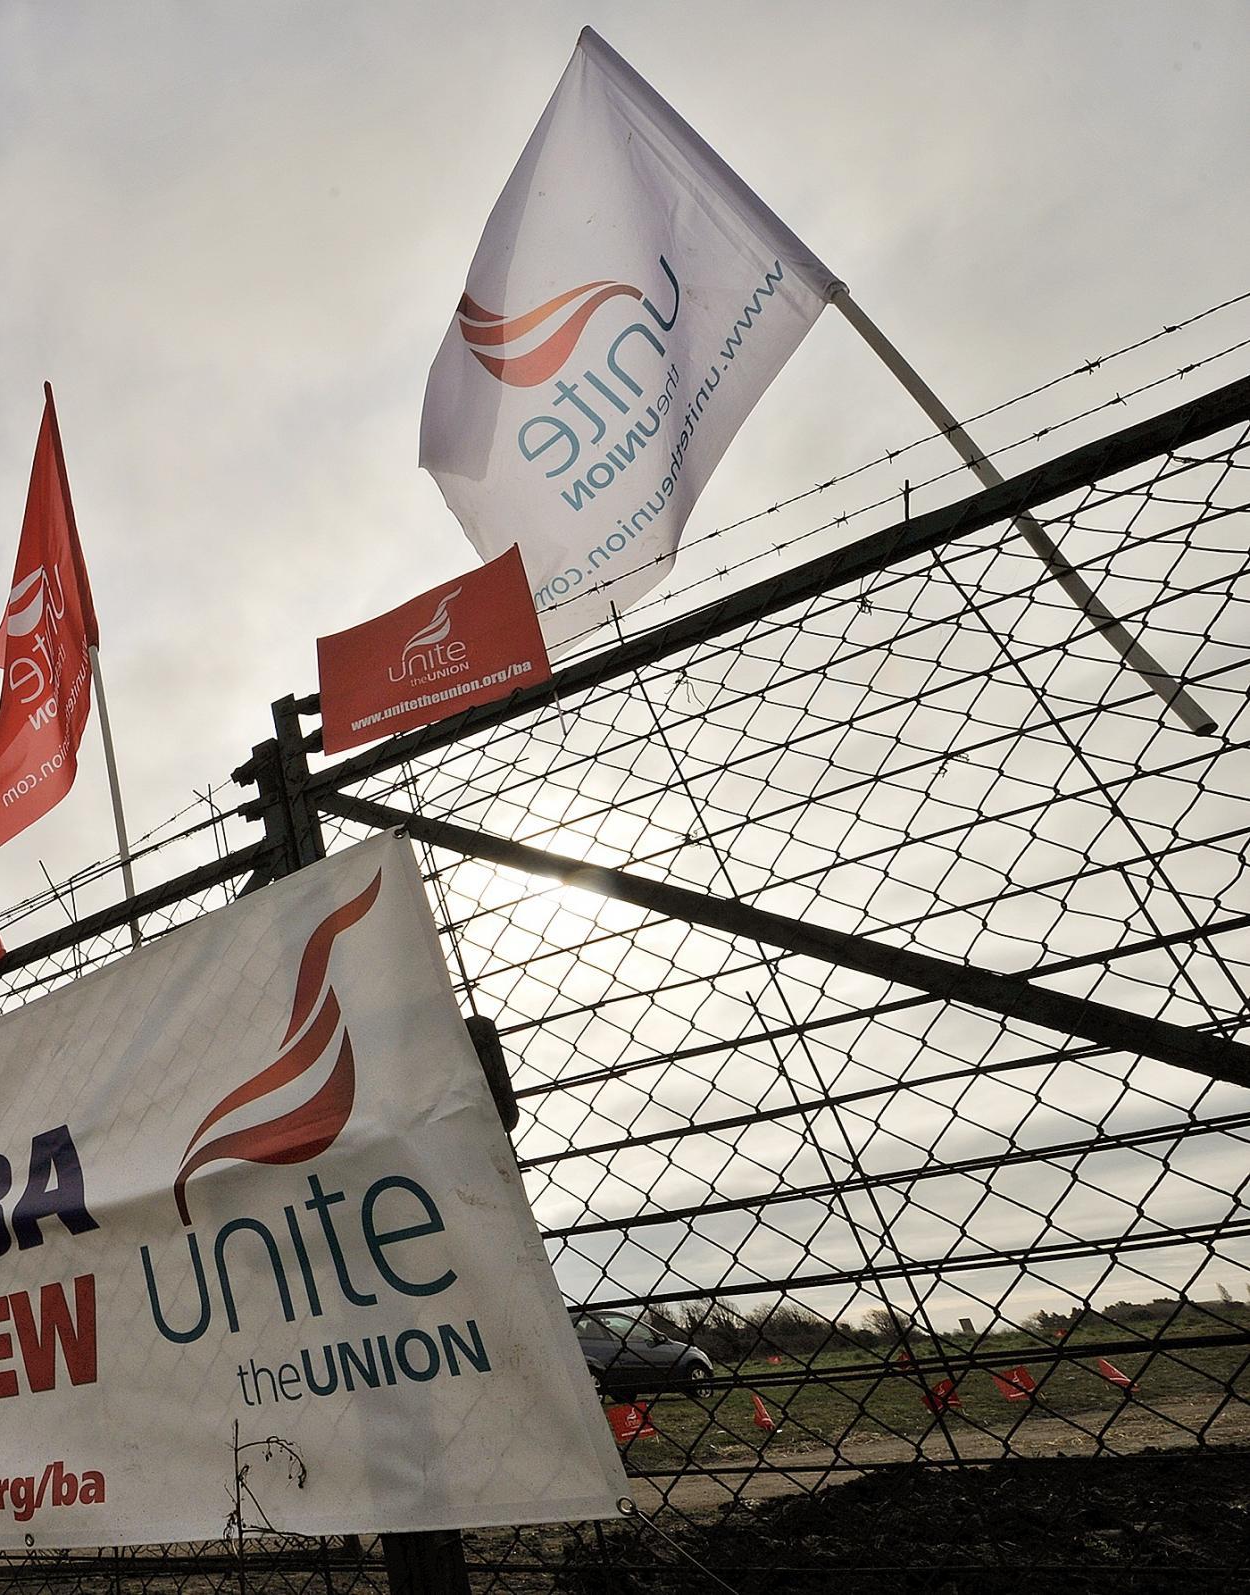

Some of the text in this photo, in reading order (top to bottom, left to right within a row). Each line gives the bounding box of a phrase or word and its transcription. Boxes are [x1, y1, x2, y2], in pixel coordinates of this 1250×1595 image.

[351, 660, 533, 732] www.unitetheunion.org/ba
[388, 641, 467, 683] unite
[410, 661, 470, 687] theUNION
[139, 1174, 458, 1345] unite
[237, 1319, 492, 1407] theUNION
